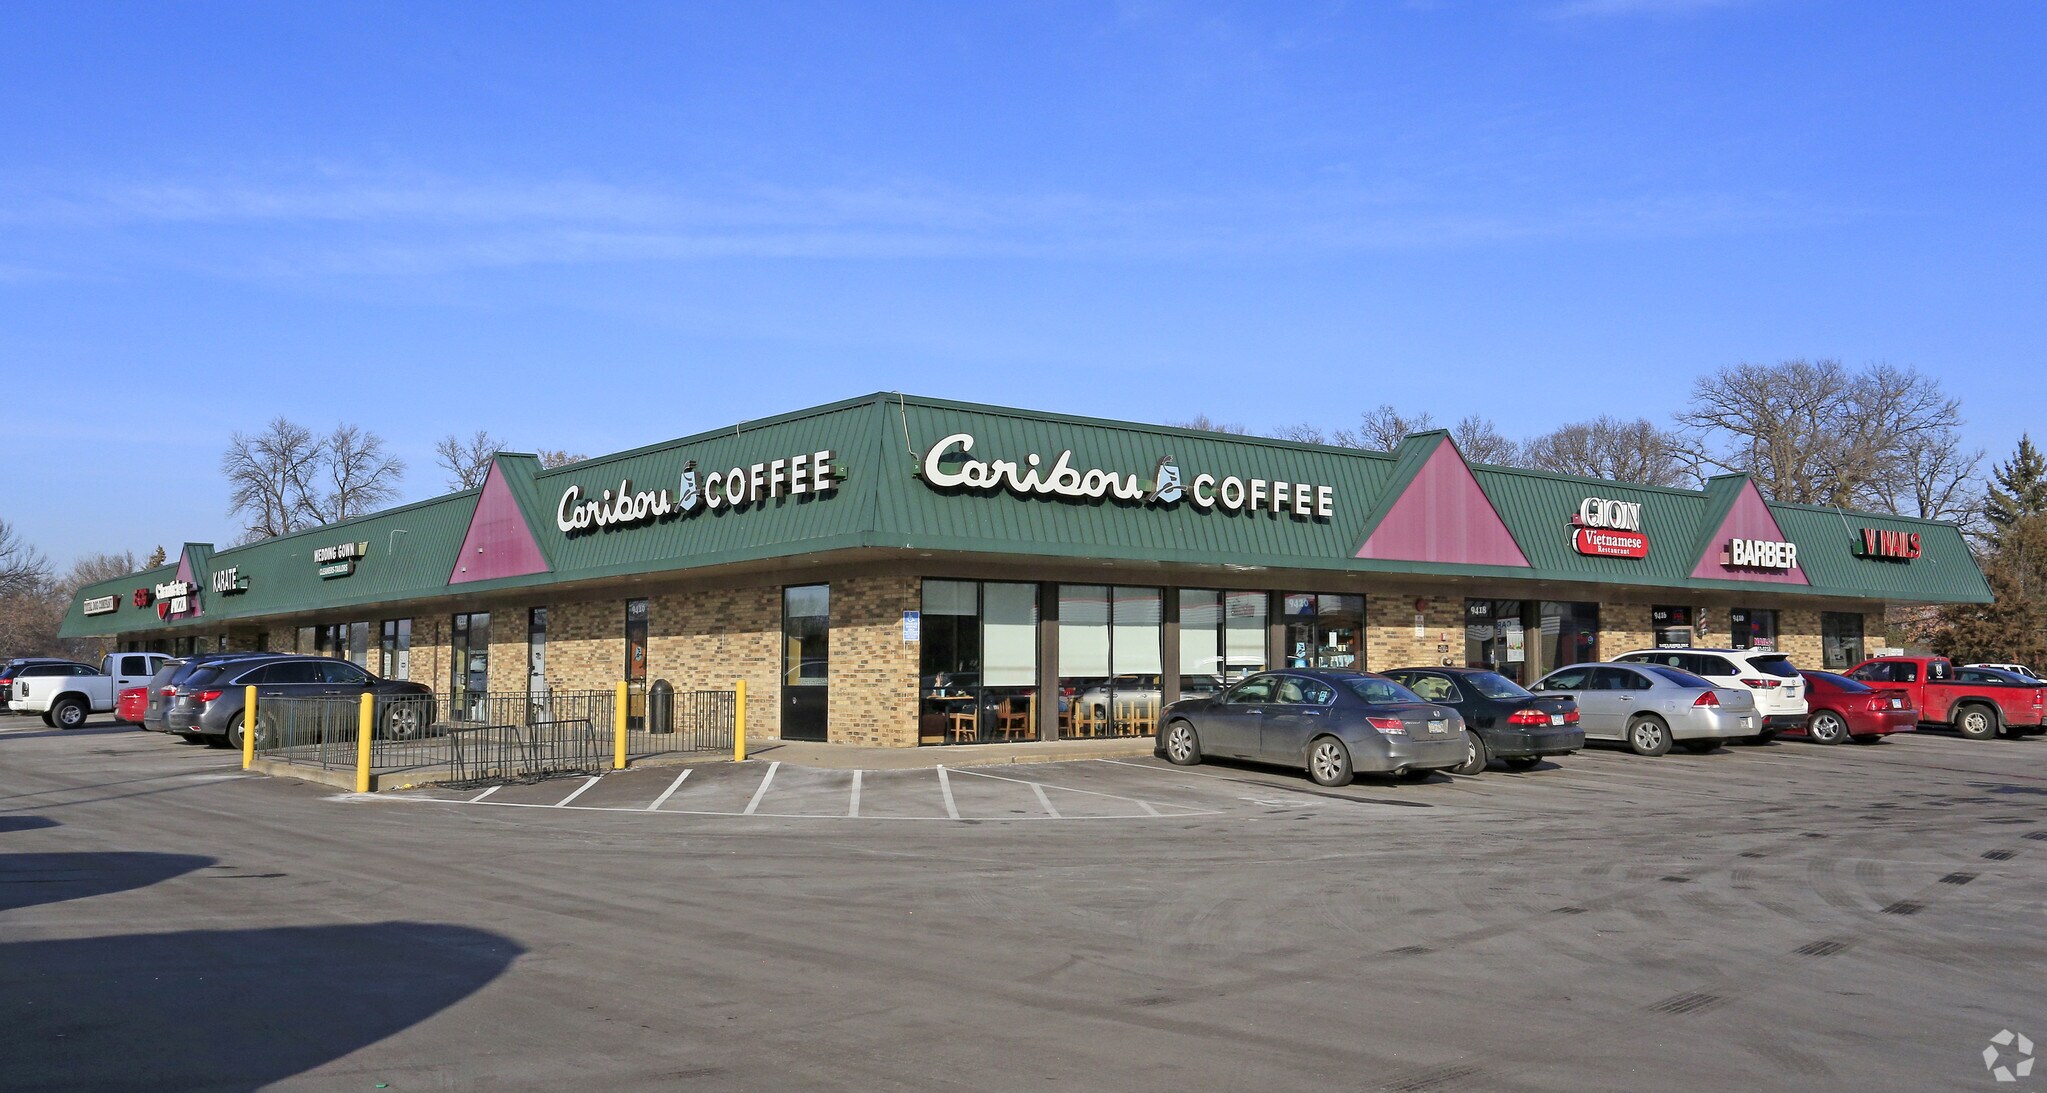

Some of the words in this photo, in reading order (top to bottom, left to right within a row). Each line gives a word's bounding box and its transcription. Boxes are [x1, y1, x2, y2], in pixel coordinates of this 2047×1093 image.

[924, 433, 1143, 500] Caribou
[1193, 473, 1333, 517] COFFEE
[557, 479, 671, 532] Caribou
[705, 450, 832, 509] COFFEE
[1581, 497, 1641, 532] GION
[314, 546, 337, 563] WEDDING
[338, 542, 355, 559] GOWN
[1585, 530, 1642, 549] Vietnamese
[1597, 546, 1630, 555] Restaurant
[1732, 538, 1797, 569] BARBER
[1863, 528, 1876, 555] V
[1880, 530, 1921, 559] NAILS
[212, 567, 237, 593] KARATE
[1470, 606, 1487, 614] 9418
